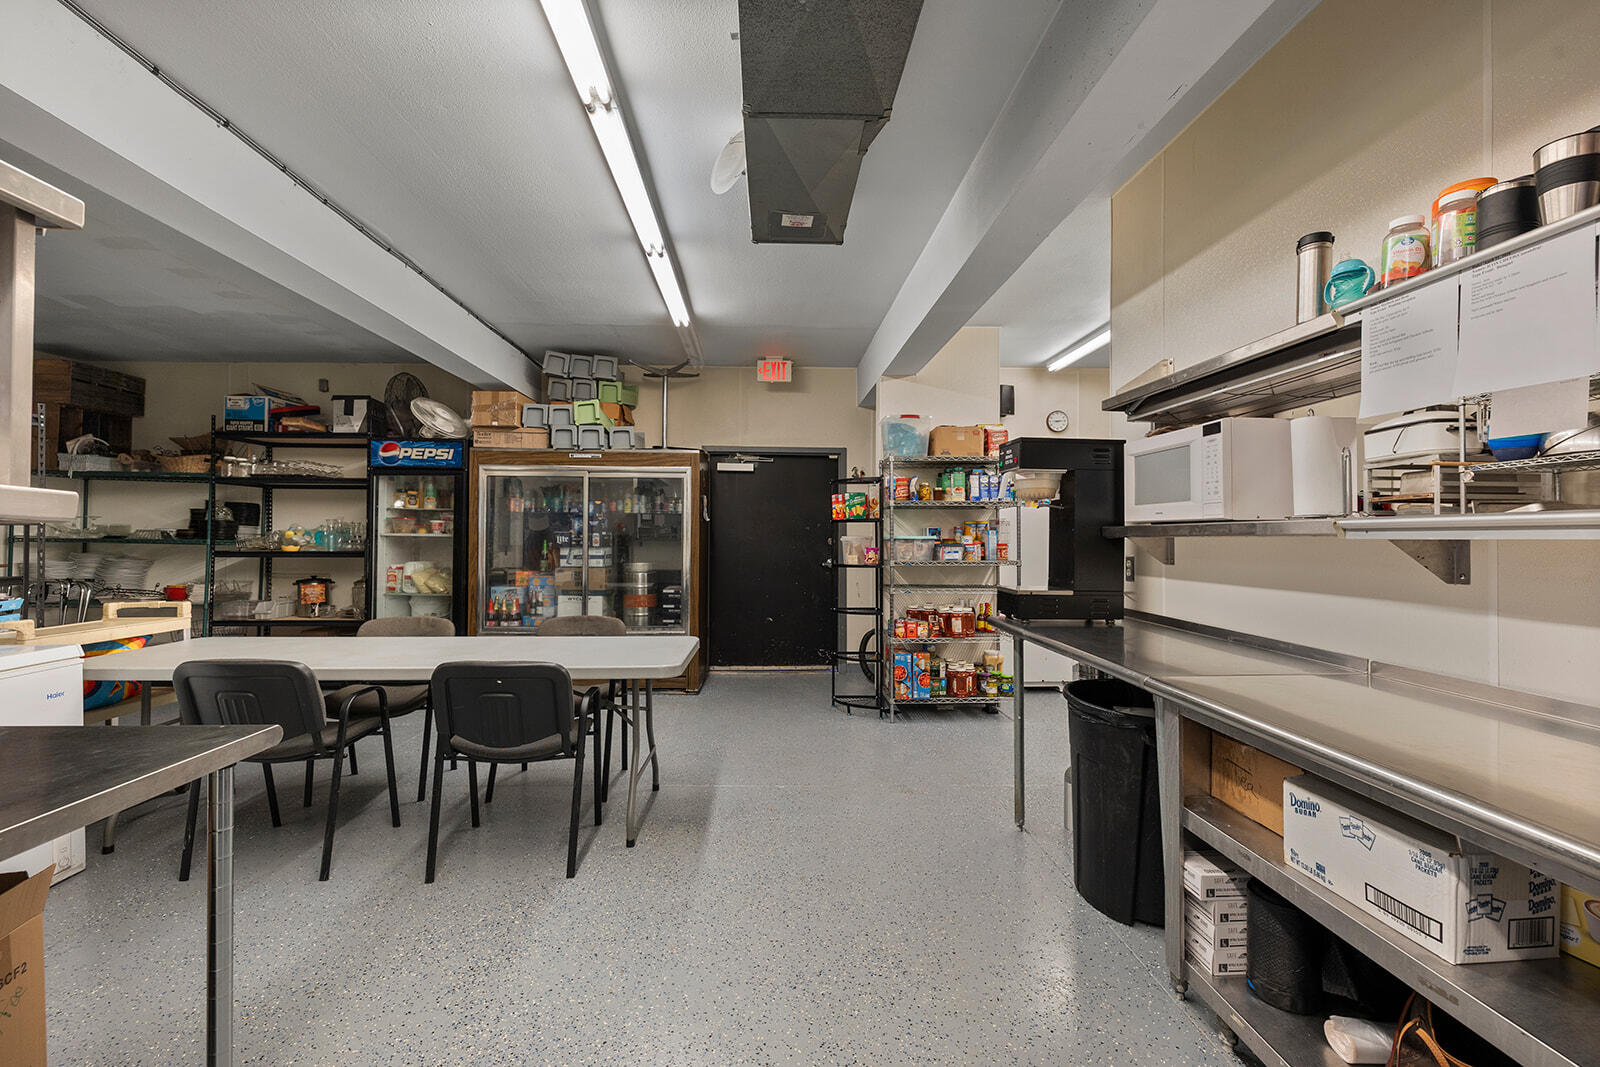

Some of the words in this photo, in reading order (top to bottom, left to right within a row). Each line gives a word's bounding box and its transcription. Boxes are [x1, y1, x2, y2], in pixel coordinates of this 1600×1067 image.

[763, 361, 787, 380] EXIT
[398, 447, 454, 460] PEPSI
[556, 535, 569, 545] Lite
[46, 691, 64, 700] Haier
[1289, 792, 1321, 812] Domino
[1295, 807, 1317, 818] SUGAR
[1528, 878, 1556, 893] Domino
[1528, 896, 1556, 911] Domino
